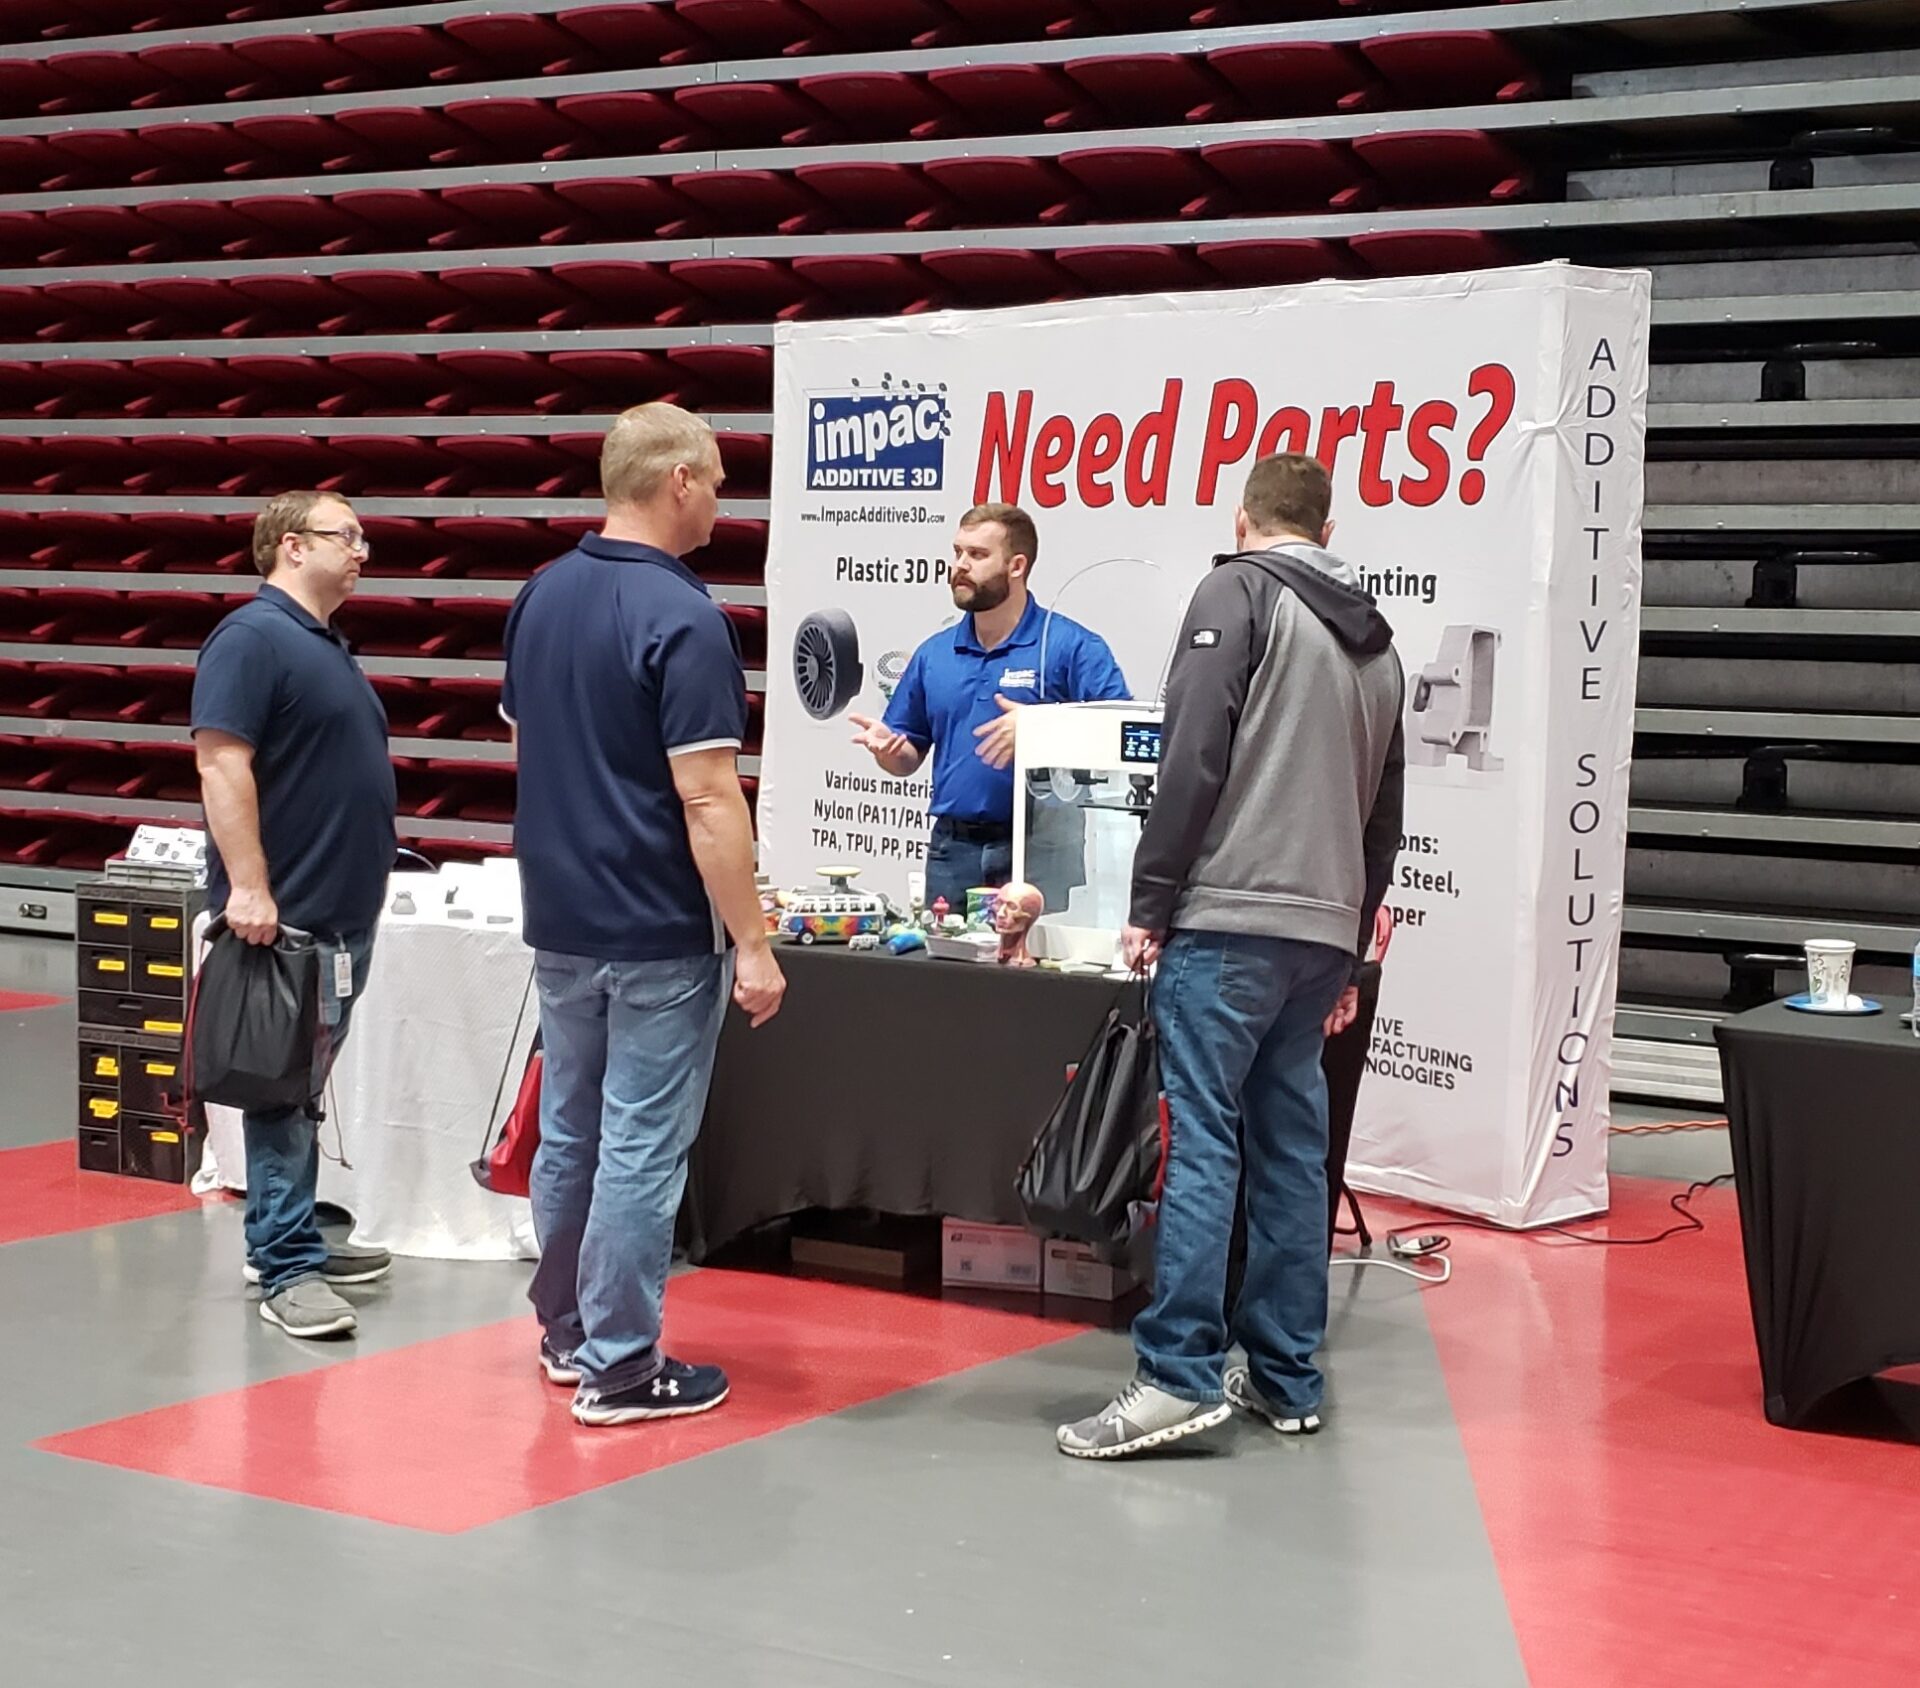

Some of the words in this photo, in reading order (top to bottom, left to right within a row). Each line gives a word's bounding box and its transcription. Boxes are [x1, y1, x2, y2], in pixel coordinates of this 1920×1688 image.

[973, 378, 1184, 508] Need
[811, 468, 905, 487] ADDITIVE
[910, 467, 938, 487] 3D
[1579, 337, 1617, 701] ADDITIVE
[836, 556, 900, 583] Plastic
[903, 558, 929, 584] 3D
[825, 770, 878, 794] Various
[814, 799, 854, 821] Nylon
[811, 828, 843, 852] TPA,
[846, 832, 878, 857] TPU,
[881, 836, 902, 861] PP,
[906, 840, 930, 860] PE
[1400, 865, 1461, 899] Steel,
[1371, 1036, 1473, 1073] FACTURING
[1364, 1056, 1456, 1091] NOLOGIES
